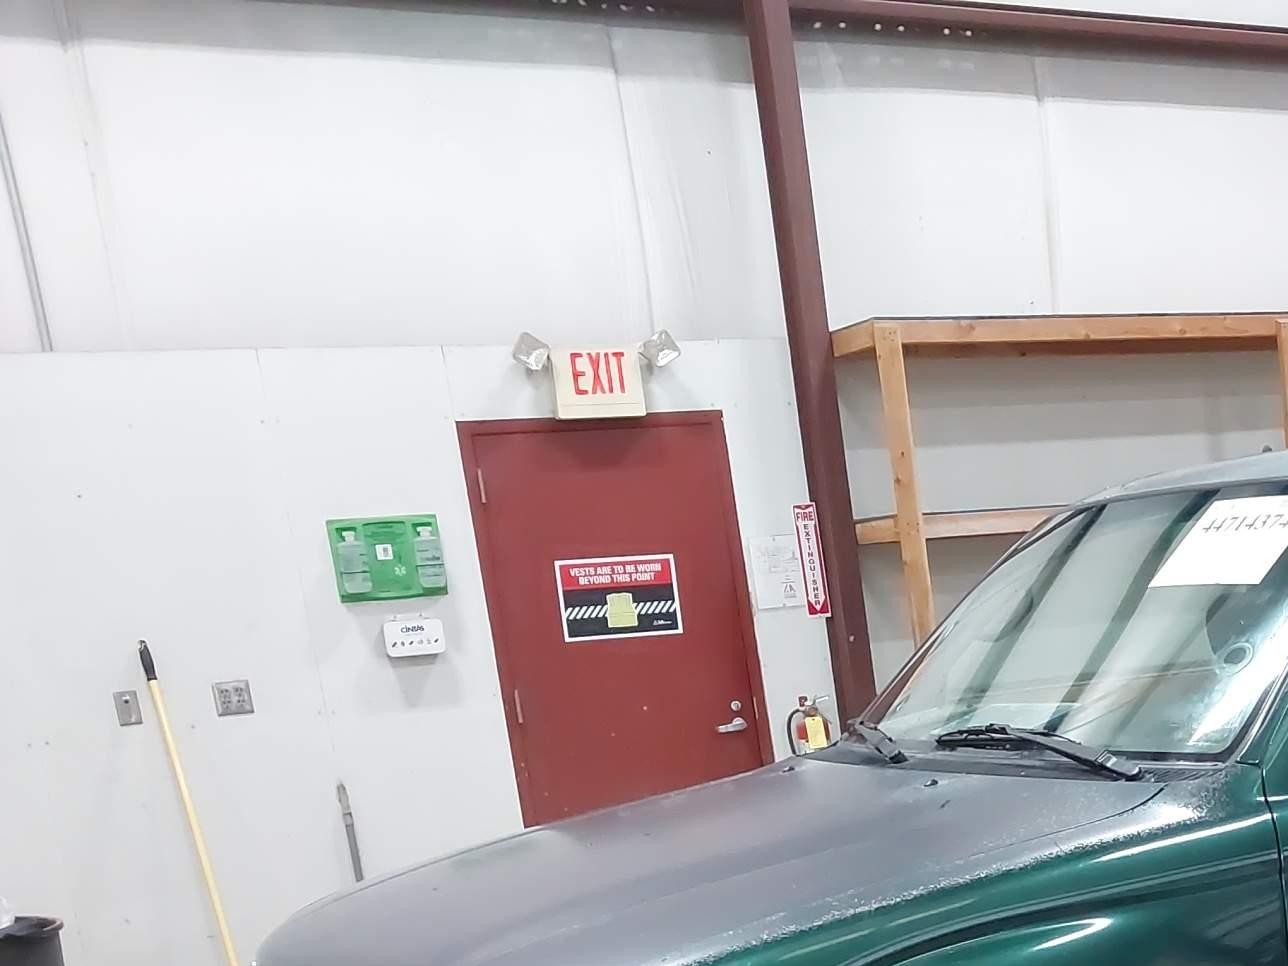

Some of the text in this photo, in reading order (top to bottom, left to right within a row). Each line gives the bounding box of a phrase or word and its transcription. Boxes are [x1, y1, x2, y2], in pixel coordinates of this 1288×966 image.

[569, 351, 626, 396] EXIT
[796, 511, 814, 521] FIRE
[569, 562, 661, 577] VESTS ARE TO BE WORN
[803, 524, 821, 606] EXTINGUISHER
[578, 571, 656, 585] BEYOND THIS POINT
